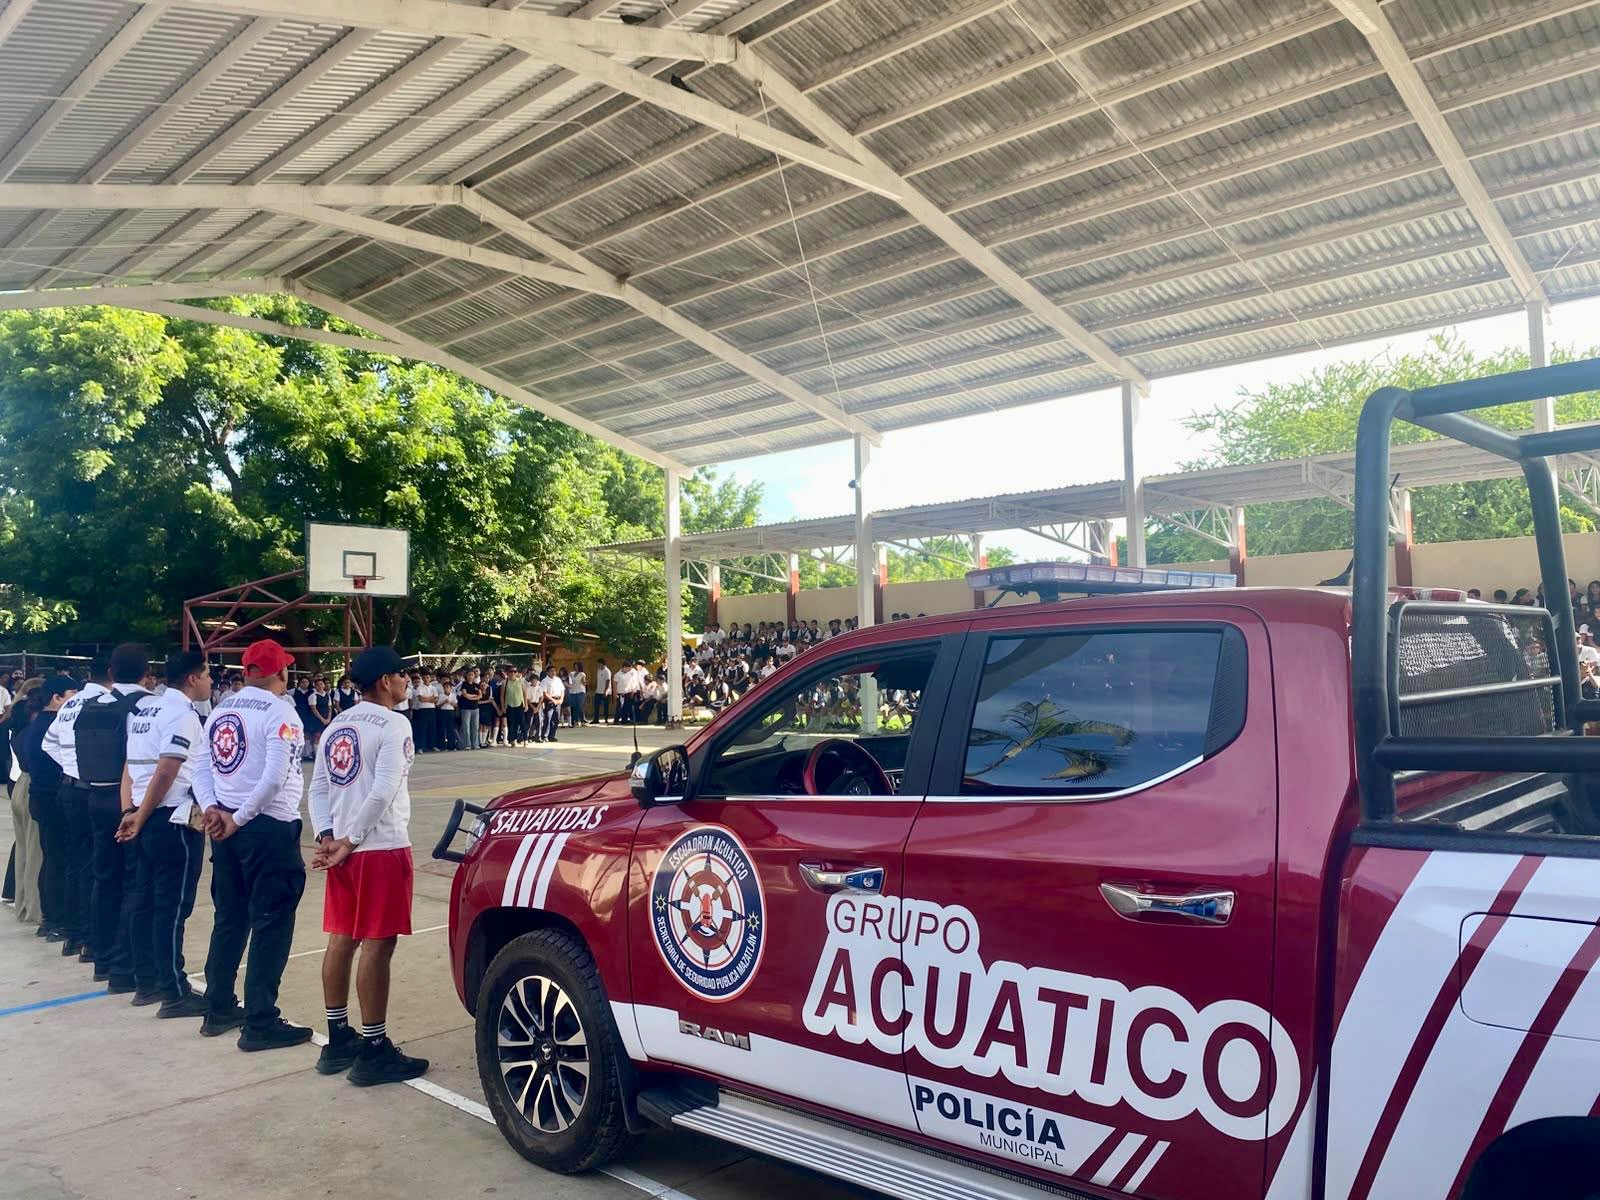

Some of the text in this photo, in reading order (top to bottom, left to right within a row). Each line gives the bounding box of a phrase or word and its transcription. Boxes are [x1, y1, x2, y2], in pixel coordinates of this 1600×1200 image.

[490, 805, 609, 834] SALVAVIDAS
[669, 835, 749, 881] ESCUADRON ACUATICO
[832, 898, 971, 954] GRUPO
[656, 916, 679, 964] SECRETARIA
[676, 959, 687, 973] DE
[684, 966, 716, 990] SEGURIDAD
[680, 1020, 751, 1051] RAM
[814, 947, 1278, 1118] ACUATICO
[915, 1084, 1065, 1150] POLICÍA
[979, 1132, 1064, 1167] MUNICIPAL
